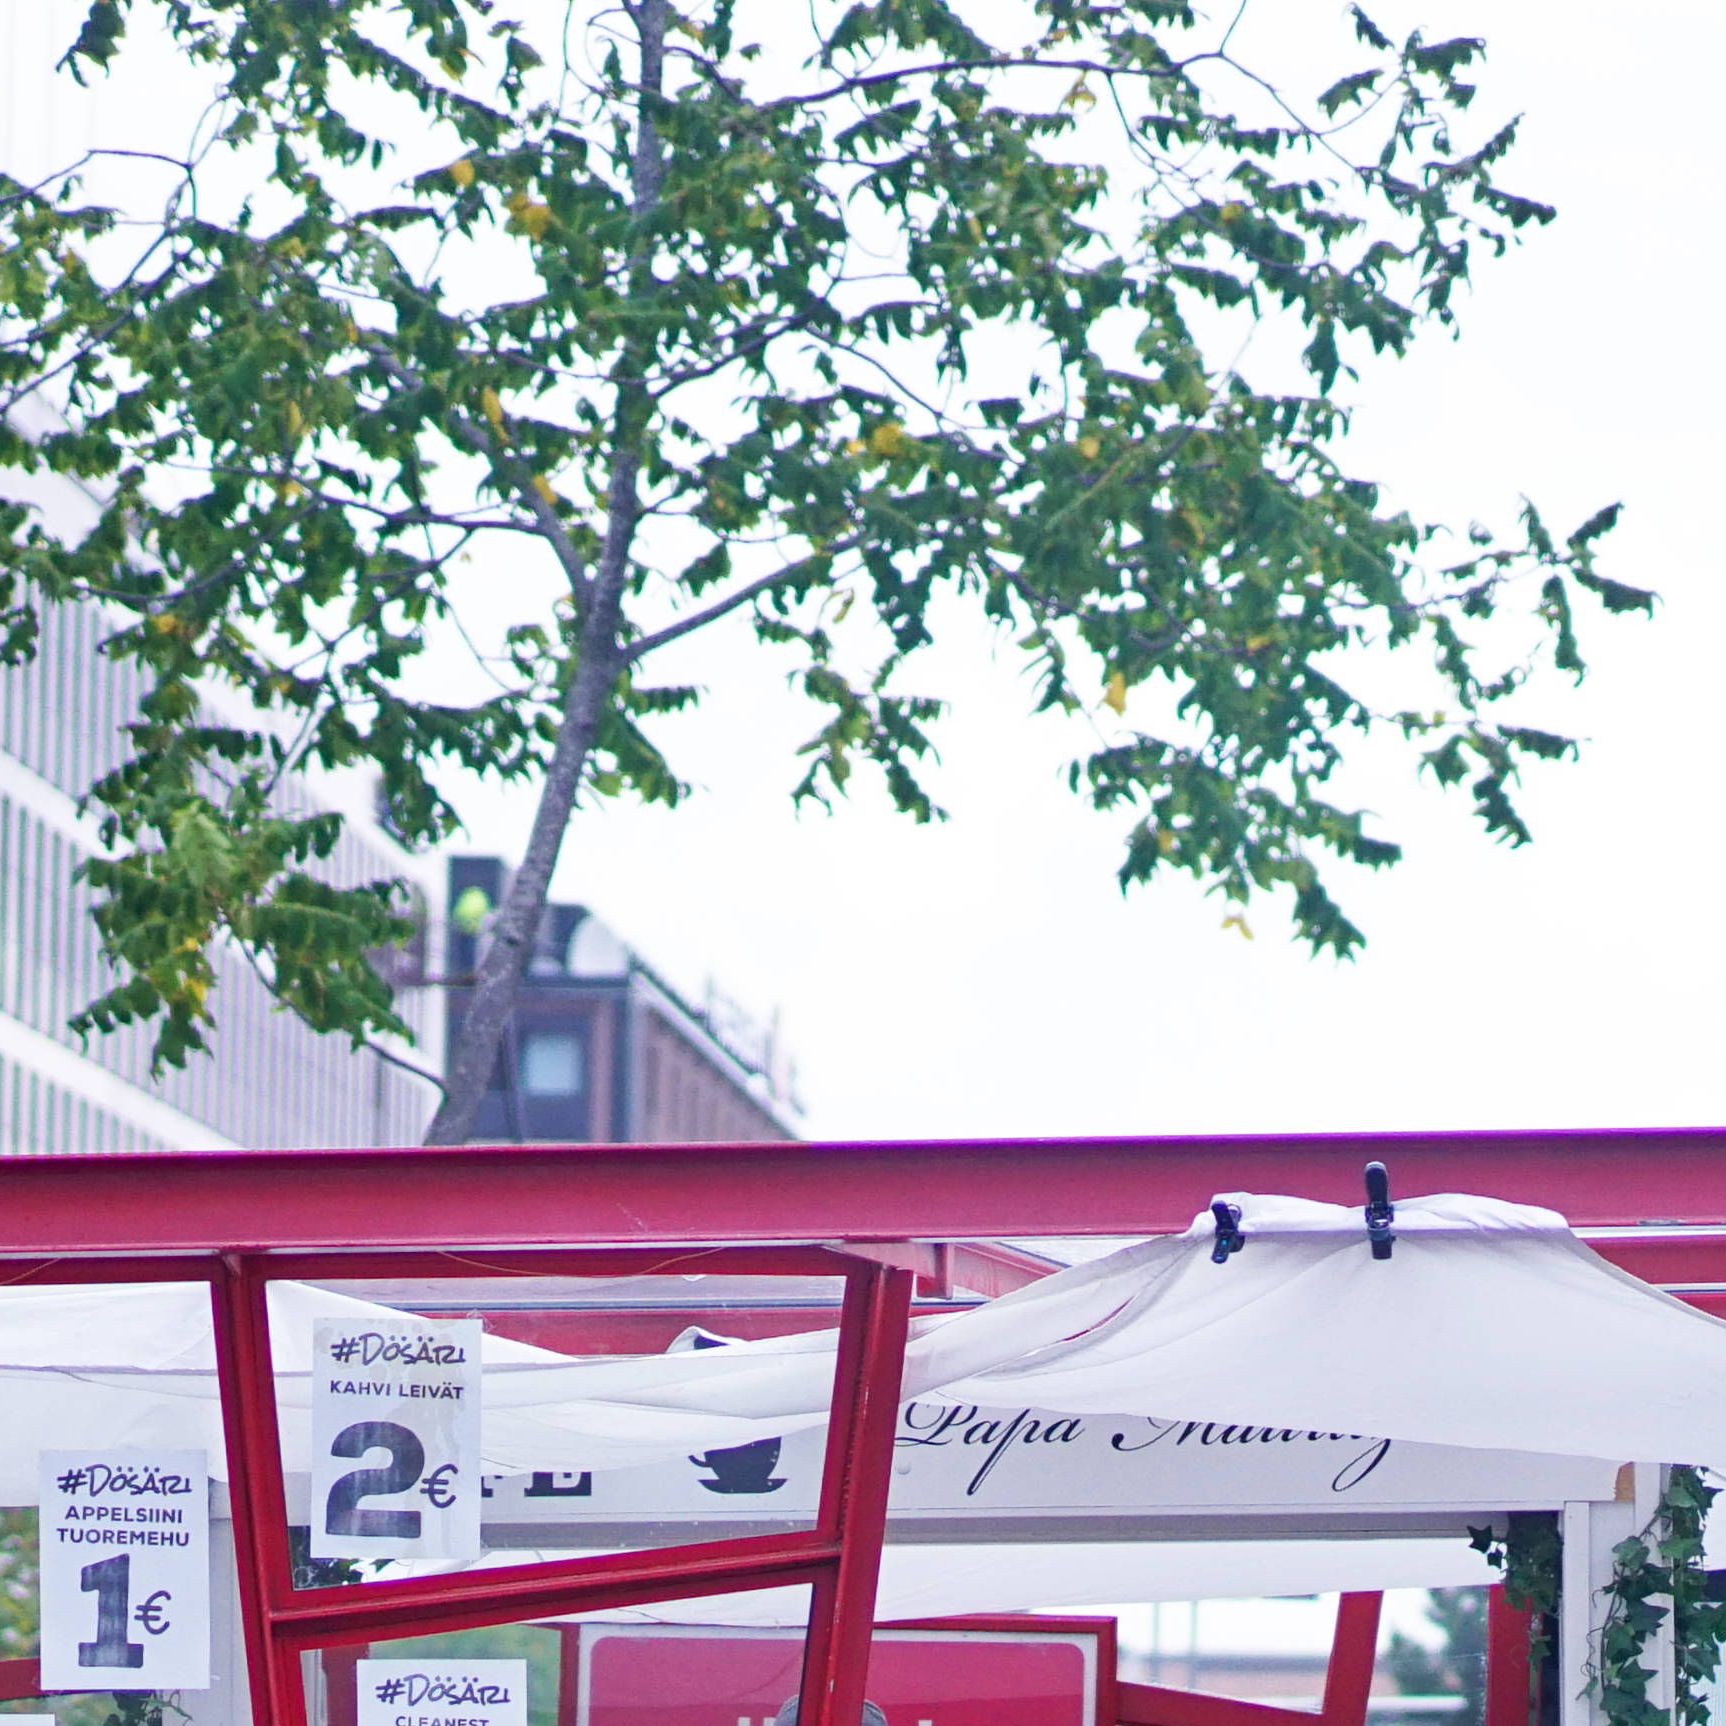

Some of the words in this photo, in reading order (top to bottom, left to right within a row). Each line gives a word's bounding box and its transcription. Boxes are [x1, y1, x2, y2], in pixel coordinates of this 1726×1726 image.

[329, 1379, 391, 1397] KAHVI
[398, 1379, 466, 1400] LEIVÄT
[324, 1421, 459, 1540] 2€
[64, 1505, 183, 1524] APPELSIINI
[56, 1527, 190, 1547] TUOREMEHU
[77, 1553, 172, 1669] 1€
